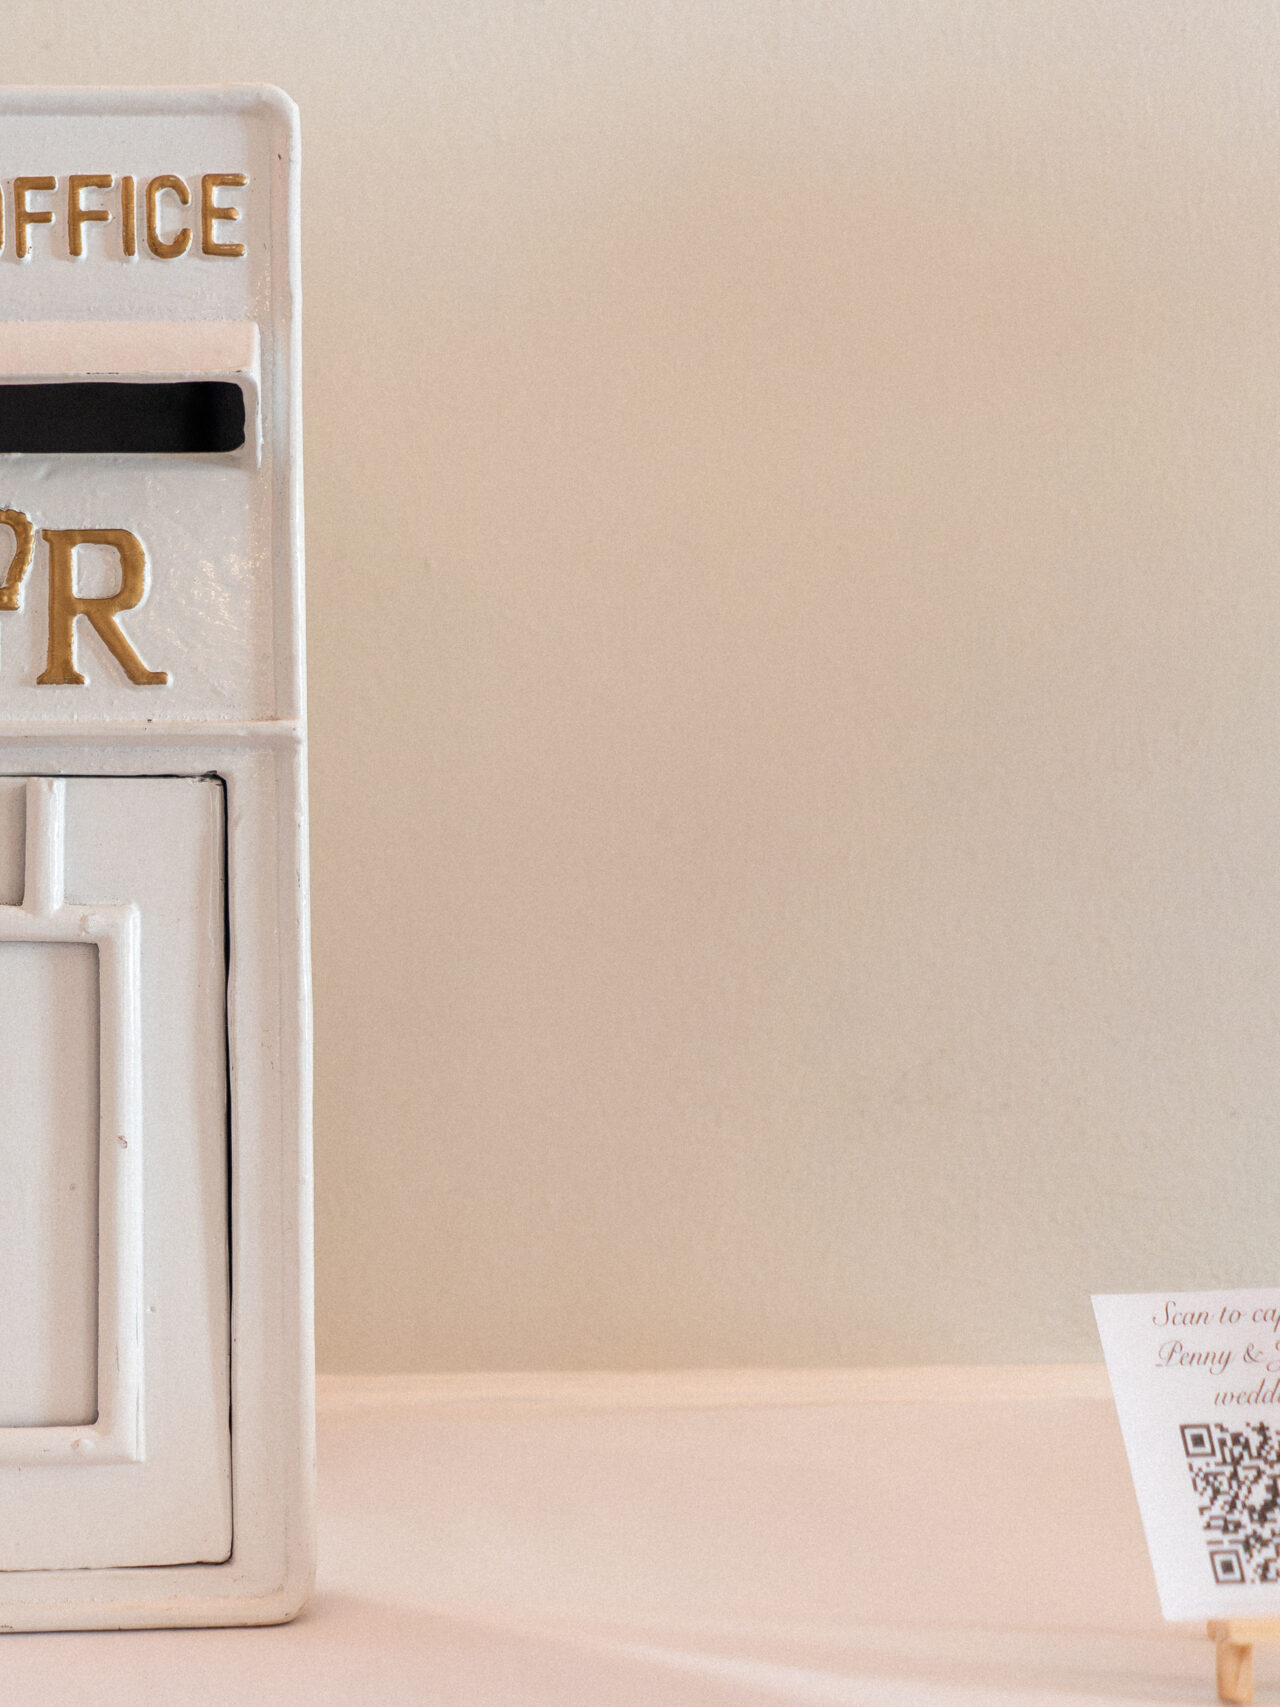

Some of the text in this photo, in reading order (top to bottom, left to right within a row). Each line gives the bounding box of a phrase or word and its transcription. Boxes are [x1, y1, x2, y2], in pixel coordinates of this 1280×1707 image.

[35, 527, 169, 685] R
[1152, 1301, 1209, 1327] Scan
[1219, 1307, 1241, 1324] to
[1155, 1340, 1231, 1375] Penny
[1243, 1343, 1263, 1363] &
